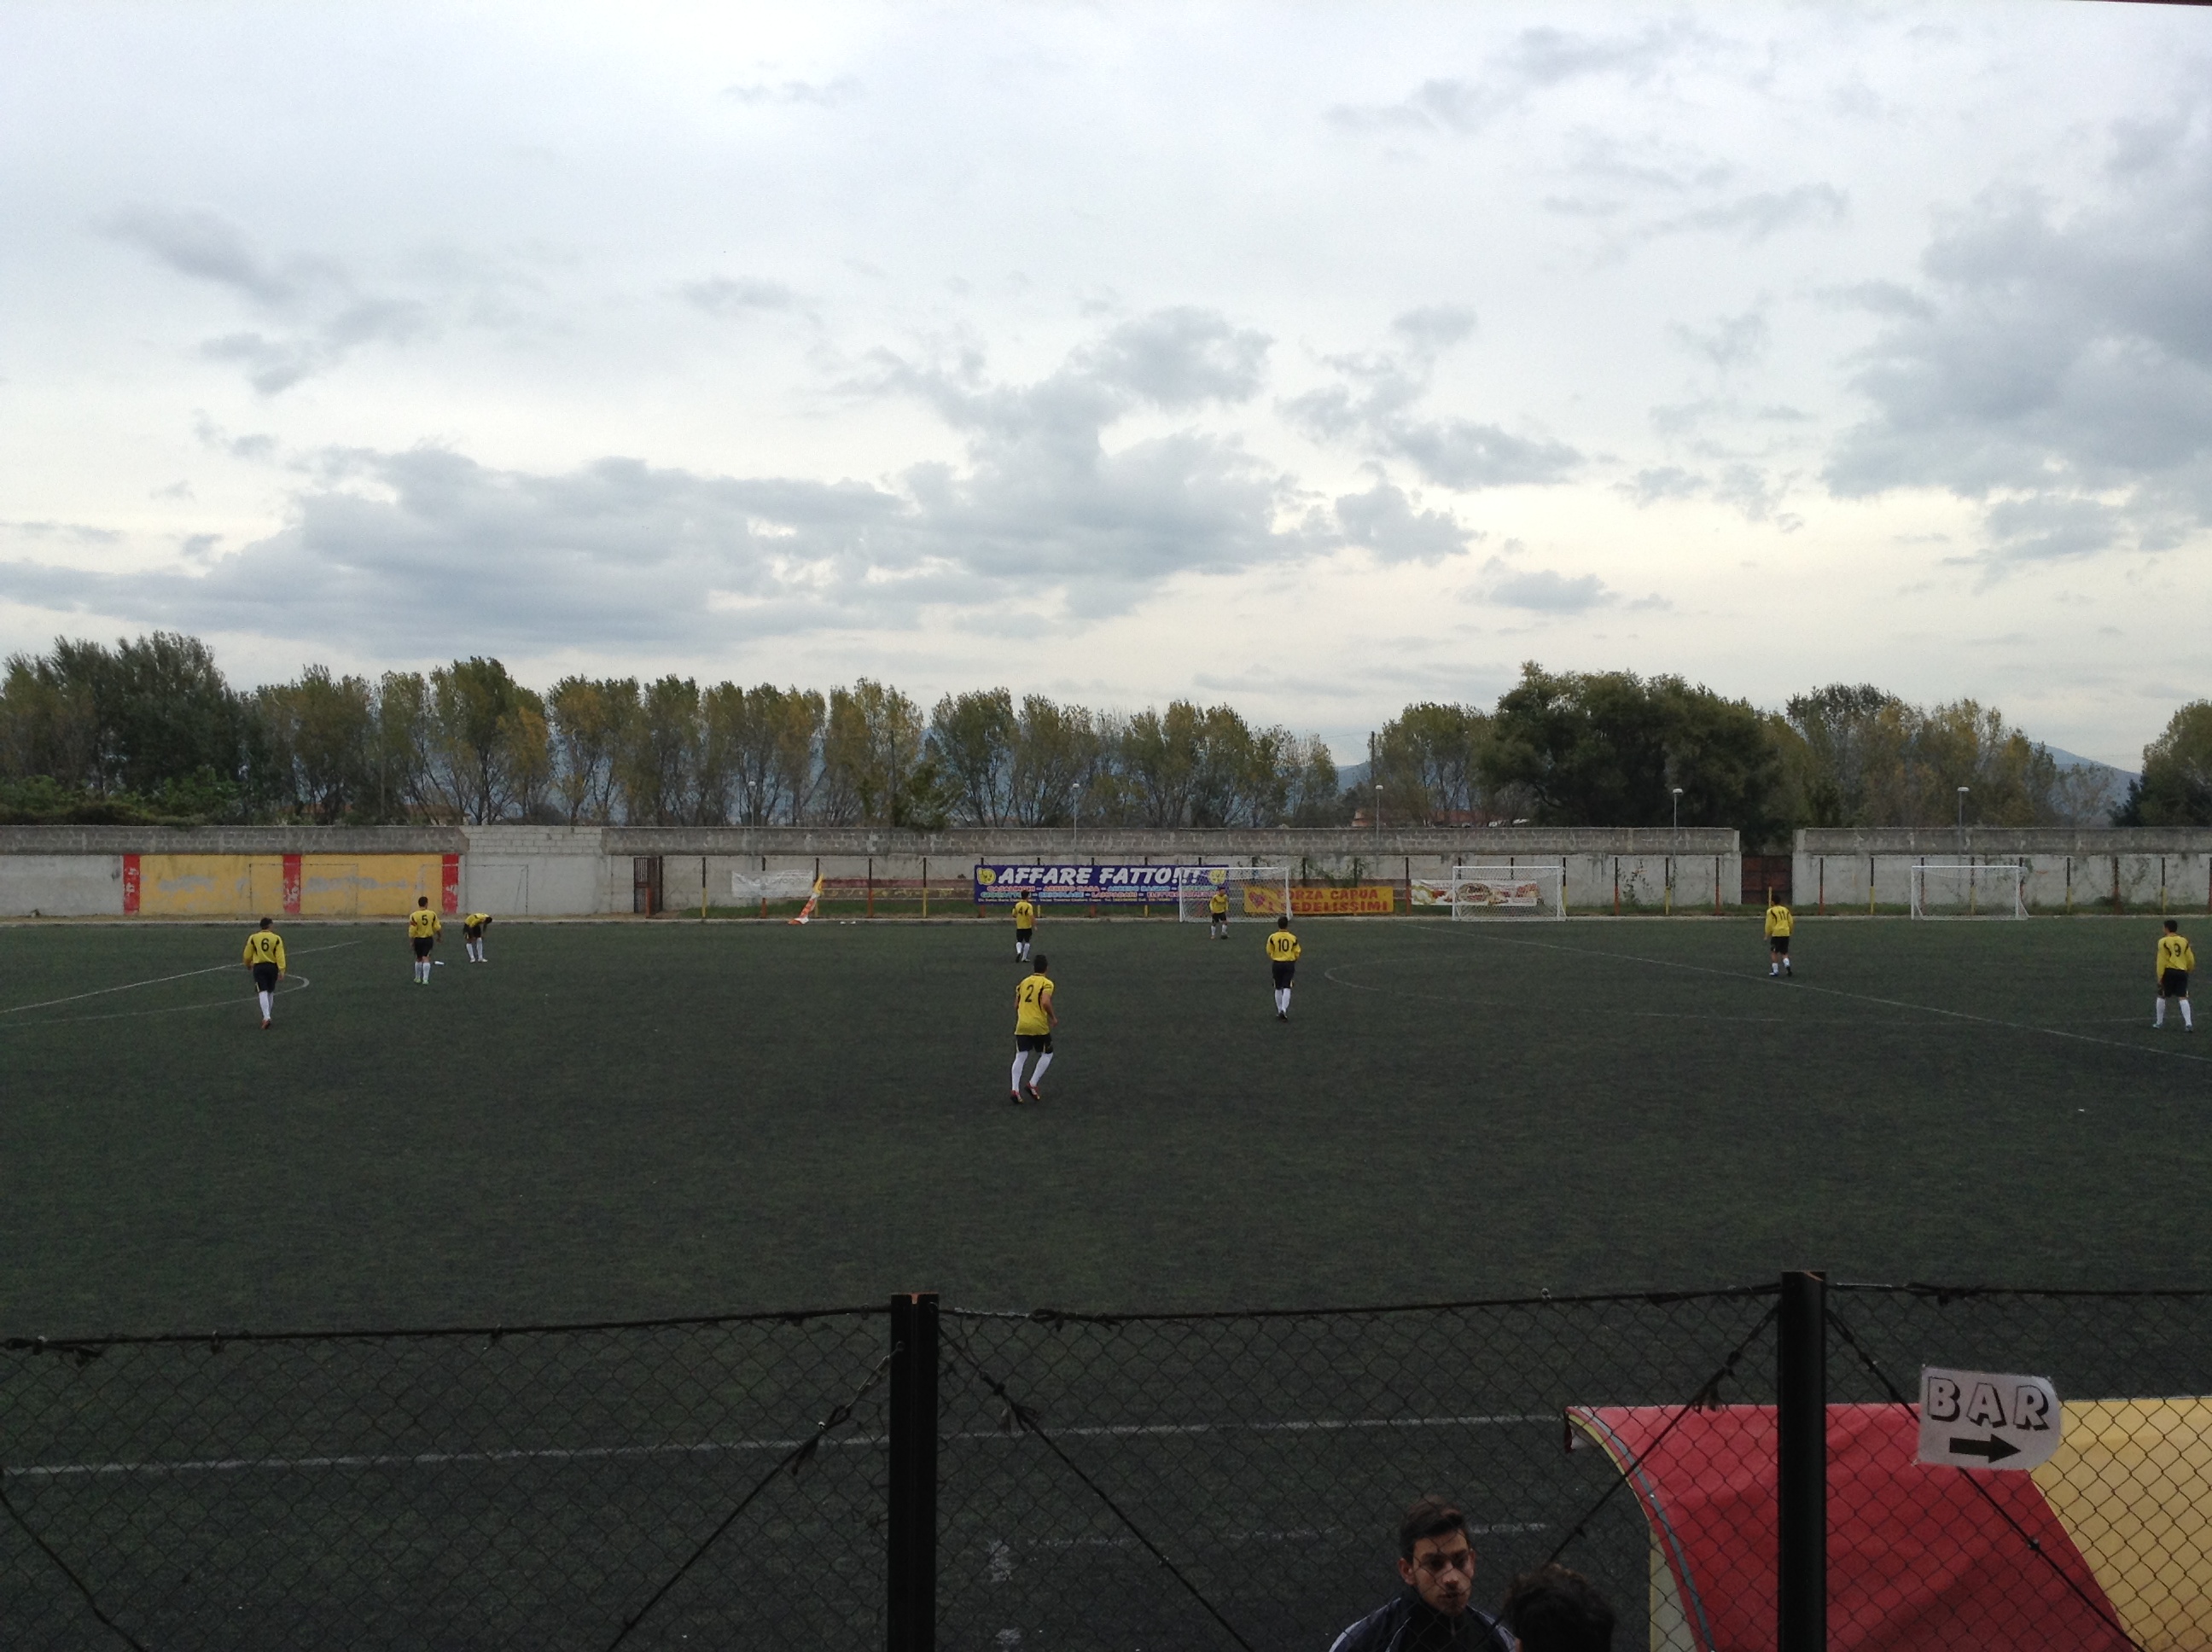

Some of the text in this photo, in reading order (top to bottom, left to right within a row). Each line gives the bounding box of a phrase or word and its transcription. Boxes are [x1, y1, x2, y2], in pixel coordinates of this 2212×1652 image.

[998, 867, 1092, 885] AFFARE
[1330, 889, 1377, 899] CAPUA
[422, 914, 428, 926] 5
[261, 938, 270, 952] 6
[1278, 939, 1289, 952] 10
[2174, 943, 2181, 957] 9
[1025, 984, 1033, 1003] 2
[1927, 1376, 2050, 1431] BAR
